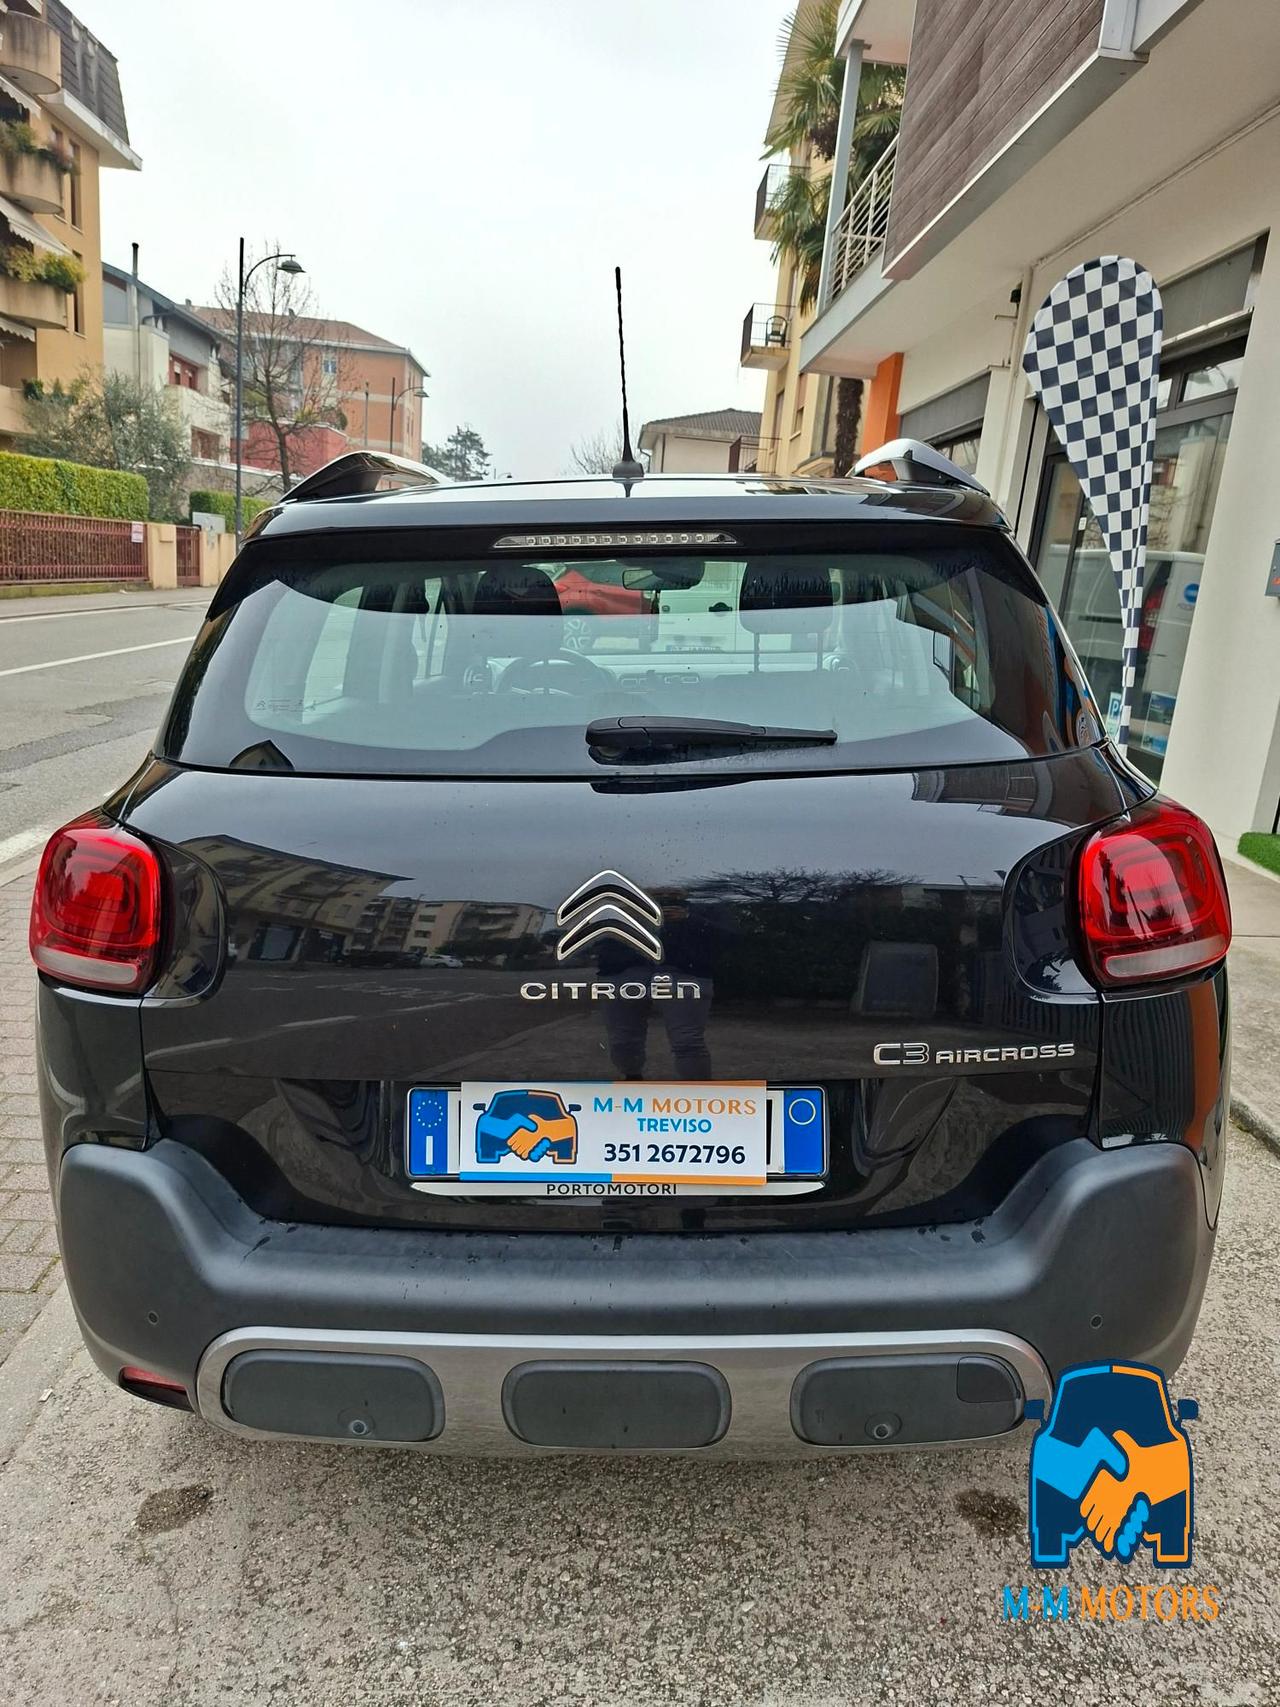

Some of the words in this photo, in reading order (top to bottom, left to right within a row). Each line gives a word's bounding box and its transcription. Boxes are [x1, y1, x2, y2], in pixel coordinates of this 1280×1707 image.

[873, 1042, 930, 1065] C3
[935, 1043, 1075, 1065] AIRCROSS
[593, 1097, 643, 1113] M-M
[652, 1098, 757, 1115] MOTORS
[637, 1117, 712, 1133] TREVISO
[546, 1183, 677, 1195] PORTOMOTORI
